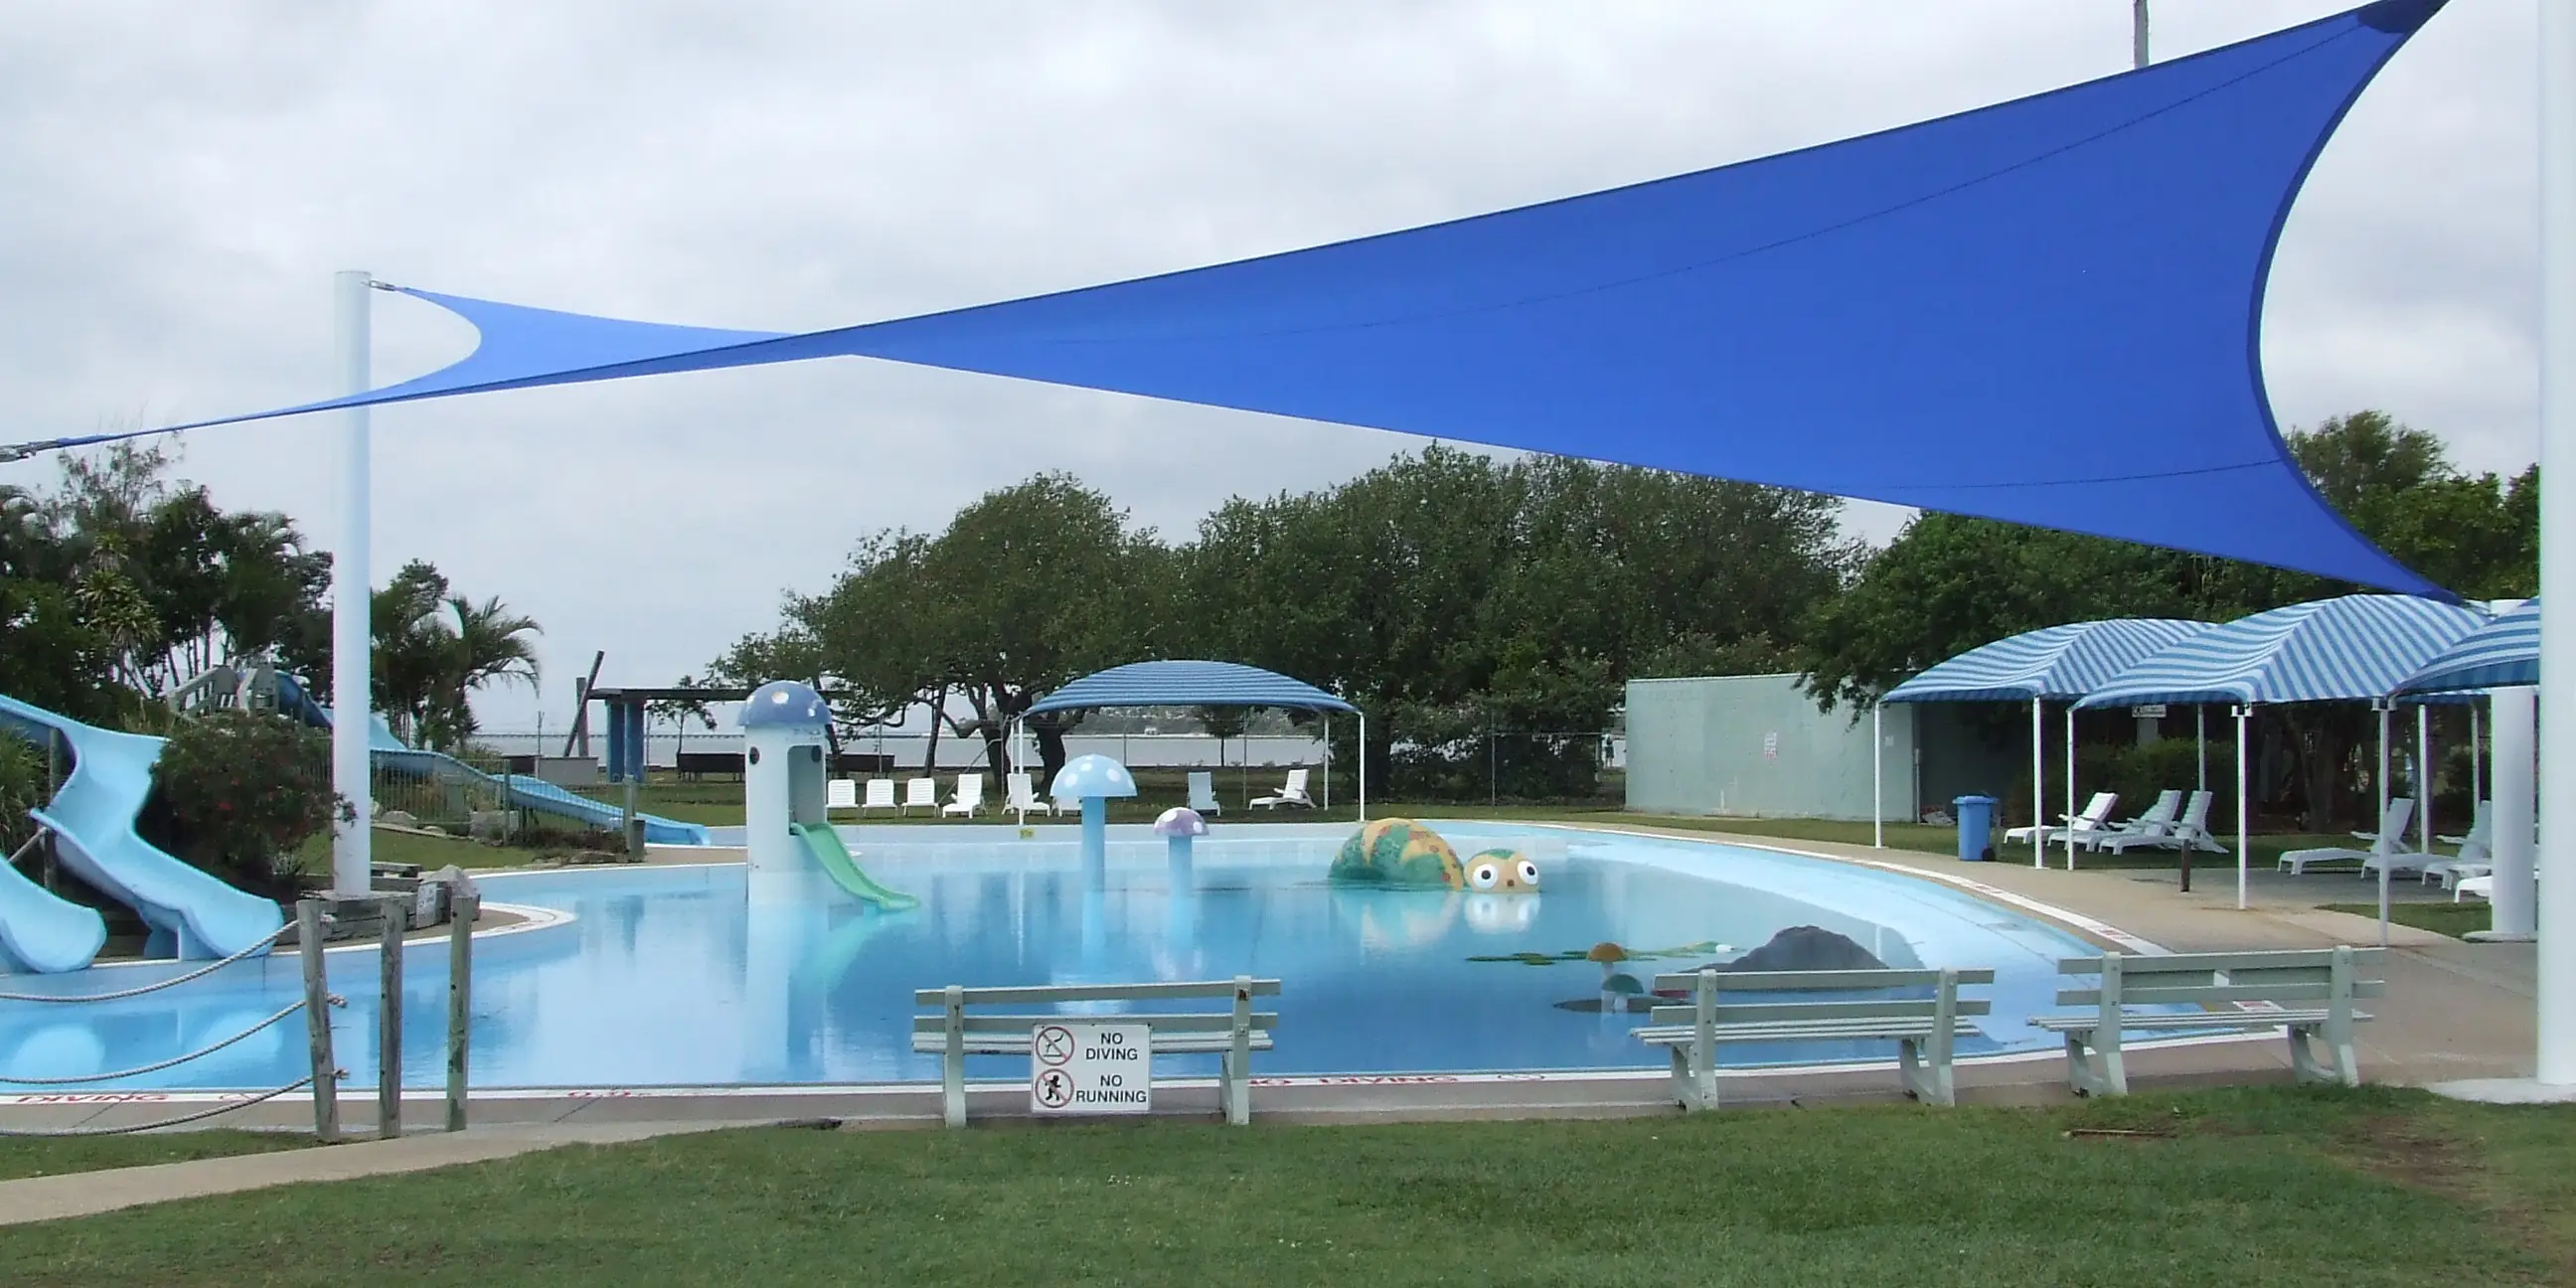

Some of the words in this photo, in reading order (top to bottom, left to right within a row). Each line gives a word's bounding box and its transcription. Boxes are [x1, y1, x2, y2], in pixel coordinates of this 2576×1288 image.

[1100, 1033, 1123, 1045] NO
[1085, 1048, 1138, 1060] DIVING
[1099, 1074, 1123, 1087] NO
[17, 1094, 169, 1103] DIVING
[1075, 1090, 1147, 1103] RUNNING
